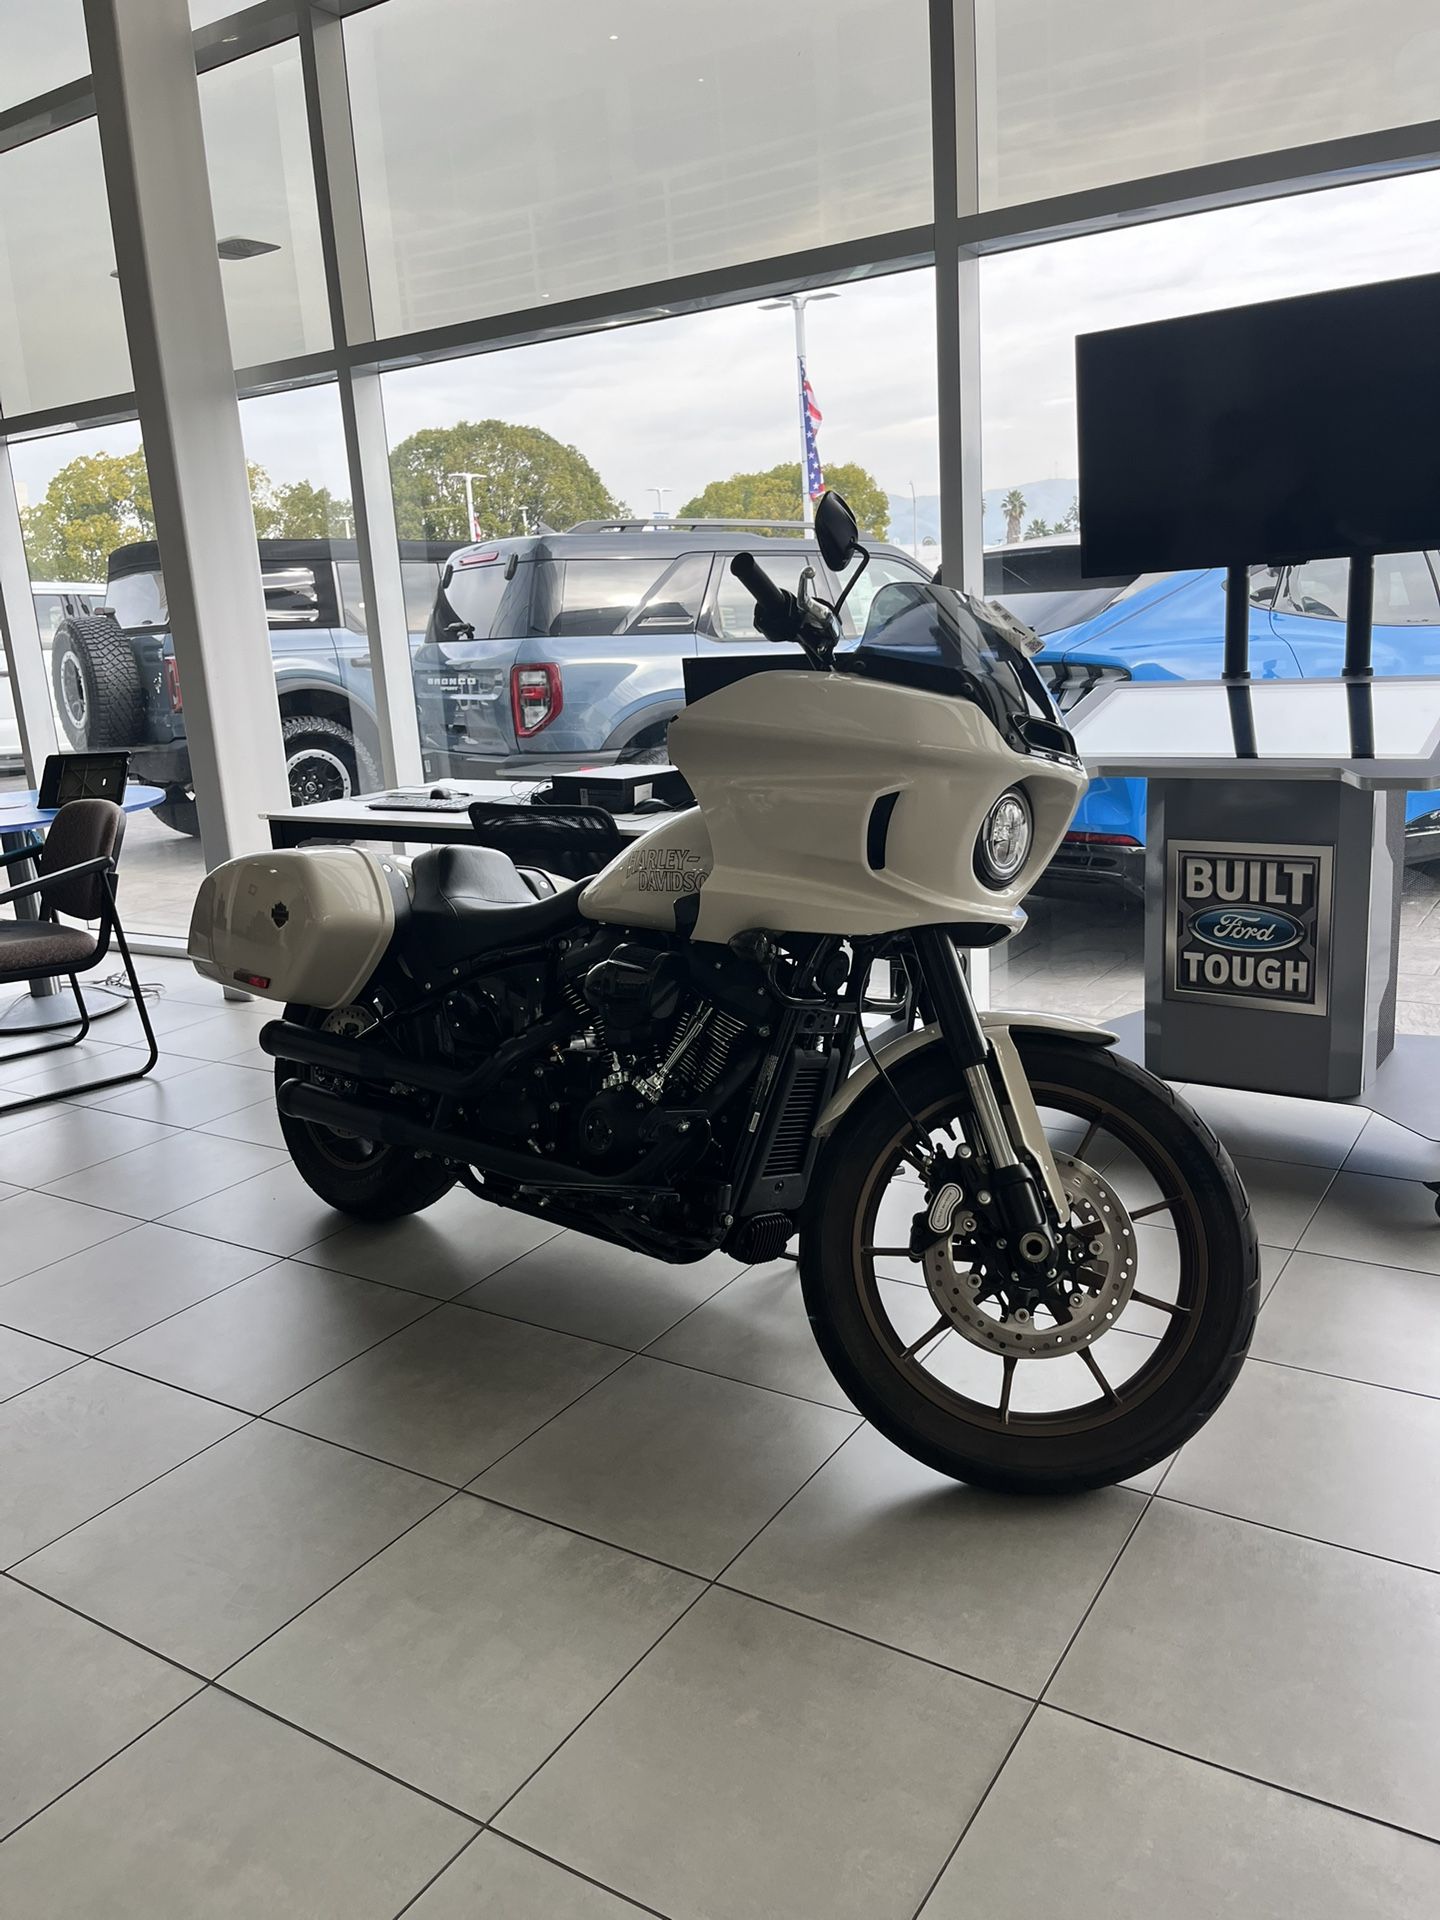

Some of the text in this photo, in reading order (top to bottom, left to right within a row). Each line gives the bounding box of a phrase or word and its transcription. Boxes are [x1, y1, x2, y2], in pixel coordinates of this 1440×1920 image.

[427, 677, 476, 685] BRONCO
[626, 849, 701, 879] HARLEY-
[1186, 858, 1313, 905] BUILT
[1213, 913, 1277, 942] Ford
[1183, 951, 1308, 993] TOUGH
